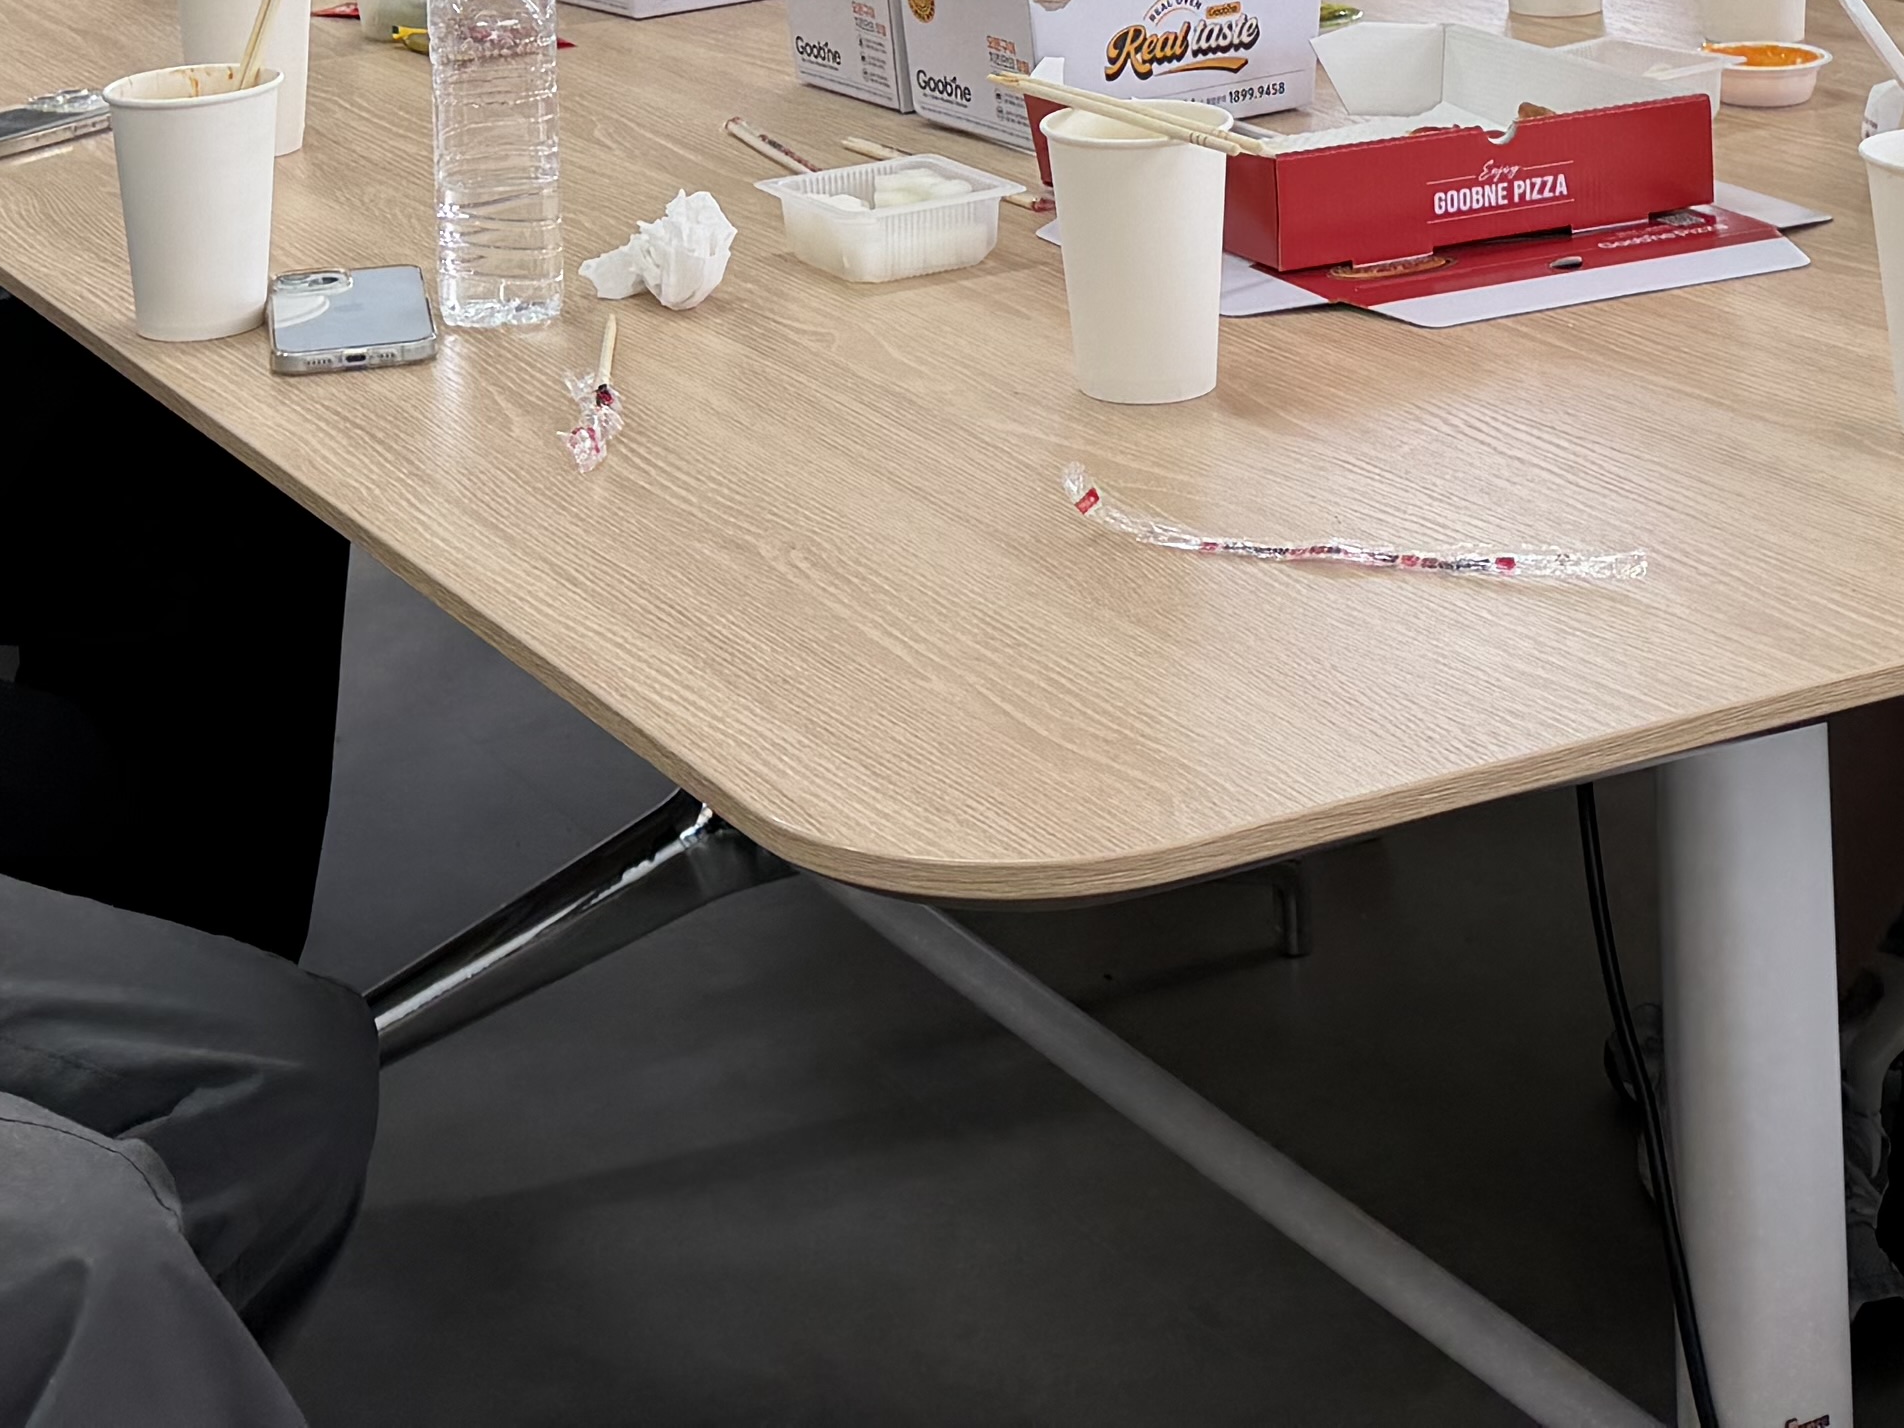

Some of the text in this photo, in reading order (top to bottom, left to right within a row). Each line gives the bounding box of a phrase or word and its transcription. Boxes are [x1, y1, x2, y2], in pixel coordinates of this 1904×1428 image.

[1149, 0, 1173, 23] REAL
[1104, 14, 1260, 82] Real taste
[1228, 81, 1286, 104] 1899.9458
[1477, 159, 1523, 182] Enjoy
[1433, 173, 1569, 216] GOOBNE PIZZA
